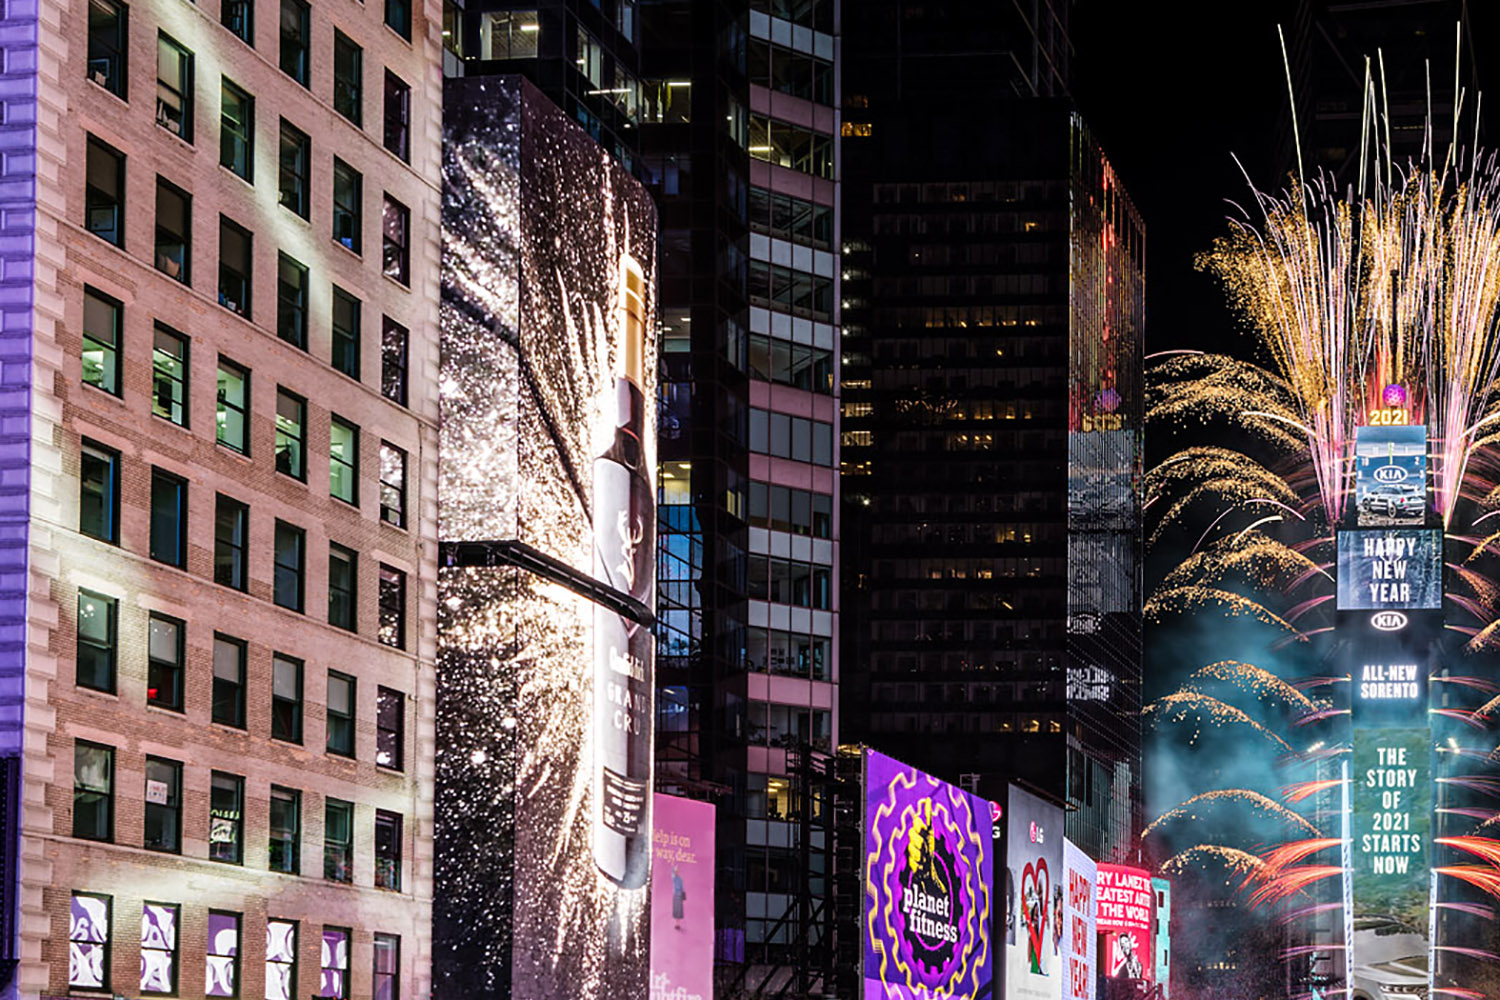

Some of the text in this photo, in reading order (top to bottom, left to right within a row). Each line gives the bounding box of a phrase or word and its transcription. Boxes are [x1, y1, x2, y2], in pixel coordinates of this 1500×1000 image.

[1369, 409, 1409, 425] 2021
[1363, 537, 1416, 557] HAPPY
[1372, 560, 1408, 580] NEW
[1369, 583, 1411, 603] YEAR
[1377, 614, 1402, 628] KIA
[1362, 665, 1417, 681] ALL-NEW
[1360, 683, 1418, 698] SORENTO
[1377, 748, 1407, 766] THE
[1366, 769, 1417, 788] STORY
[1382, 791, 1401, 809] OF
[1372, 813, 1410, 831] 2021
[652, 830, 669, 849] elp
[1362, 835, 1421, 853] STARTS
[1373, 857, 1409, 875] NOW
[903, 886, 950, 916] planet
[1097, 887, 1134, 903] EATEST
[909, 914, 958, 943] fitness
